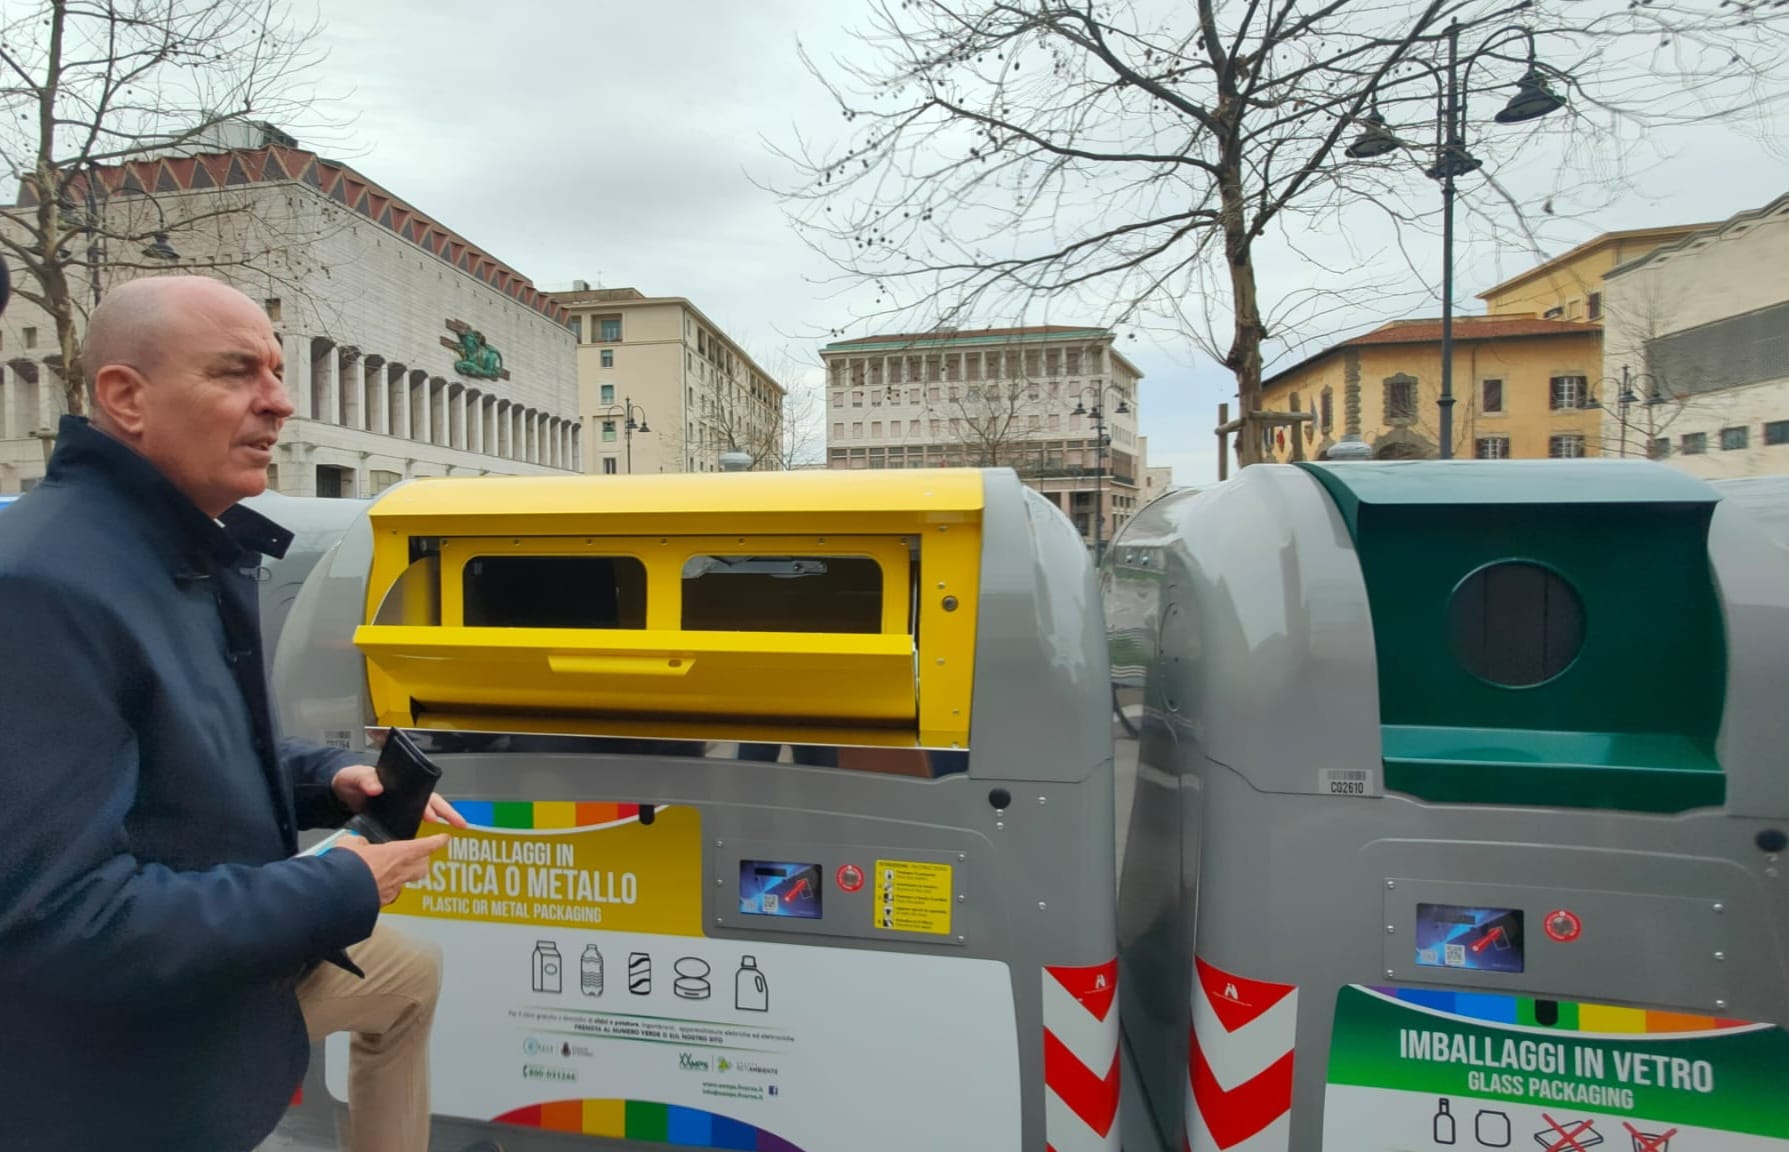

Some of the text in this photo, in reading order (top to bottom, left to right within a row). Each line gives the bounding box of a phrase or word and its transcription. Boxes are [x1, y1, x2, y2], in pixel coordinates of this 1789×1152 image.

[448, 837, 574, 867] IMBALLAGGI IN
[505, 866, 520, 897] O
[528, 869, 637, 904] METALLO
[422, 896, 602, 923] PLASTIC OR METAL PACKAGING
[1400, 1029, 1714, 1093] IMBALLAGGI IN VETRO
[1468, 1070, 1634, 1109] GLASS PACKAGING
